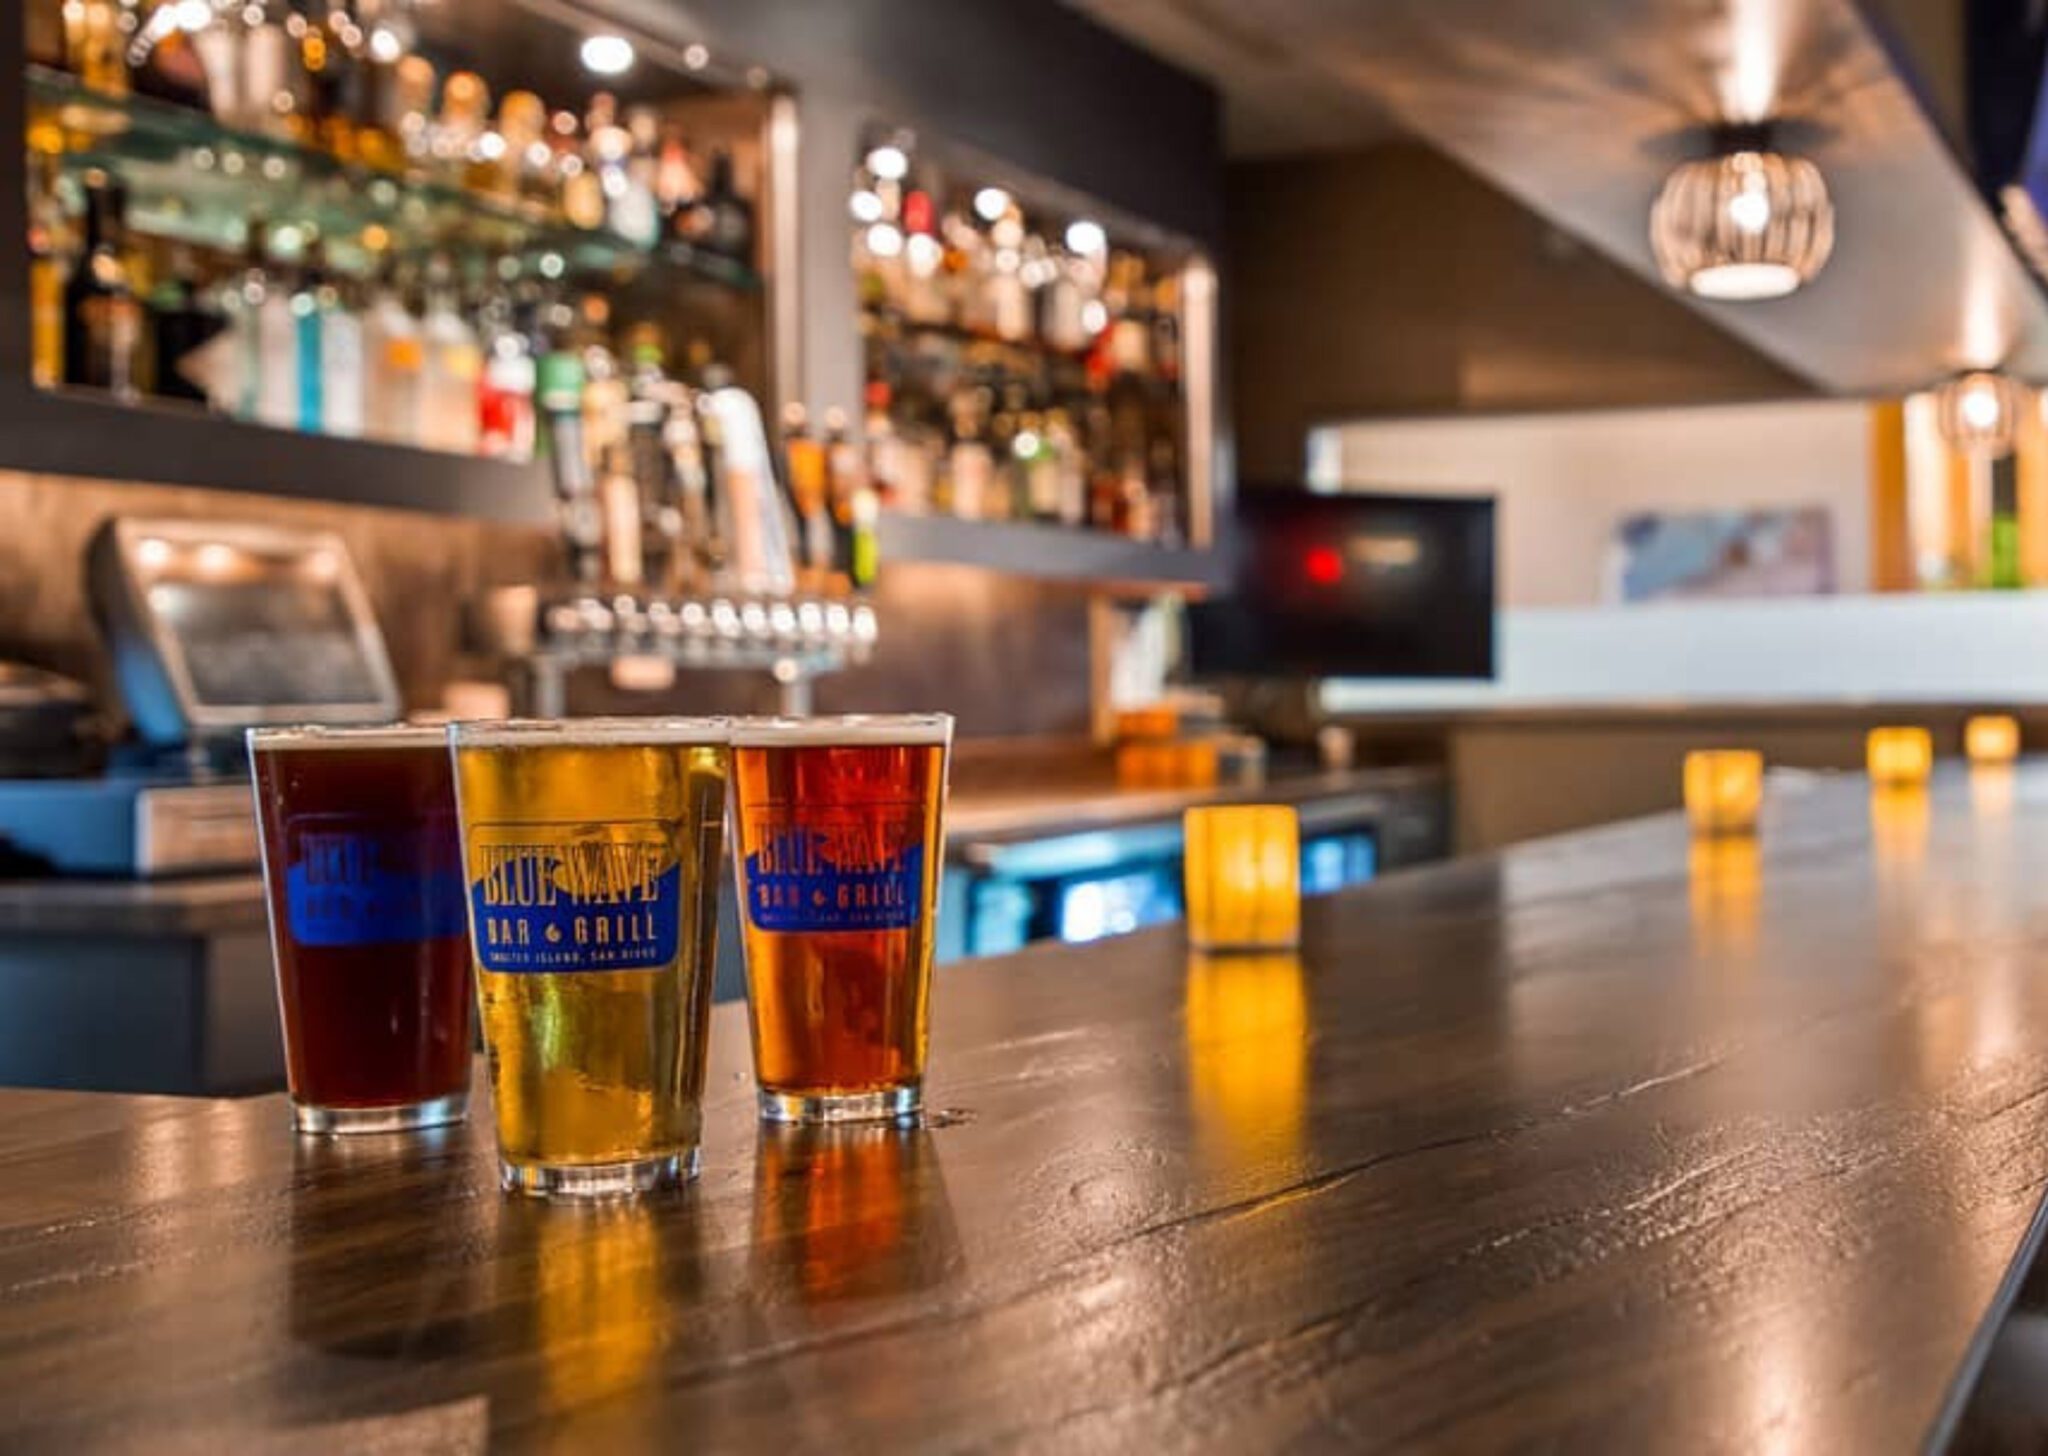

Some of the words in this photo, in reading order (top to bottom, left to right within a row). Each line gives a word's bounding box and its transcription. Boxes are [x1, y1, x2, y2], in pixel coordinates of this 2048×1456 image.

[479, 844, 557, 906] BLUE
[560, 842, 664, 905] WAVE
[836, 882, 905, 909] GRILL
[488, 918, 530, 945] BAR
[574, 914, 657, 943] GRILL
